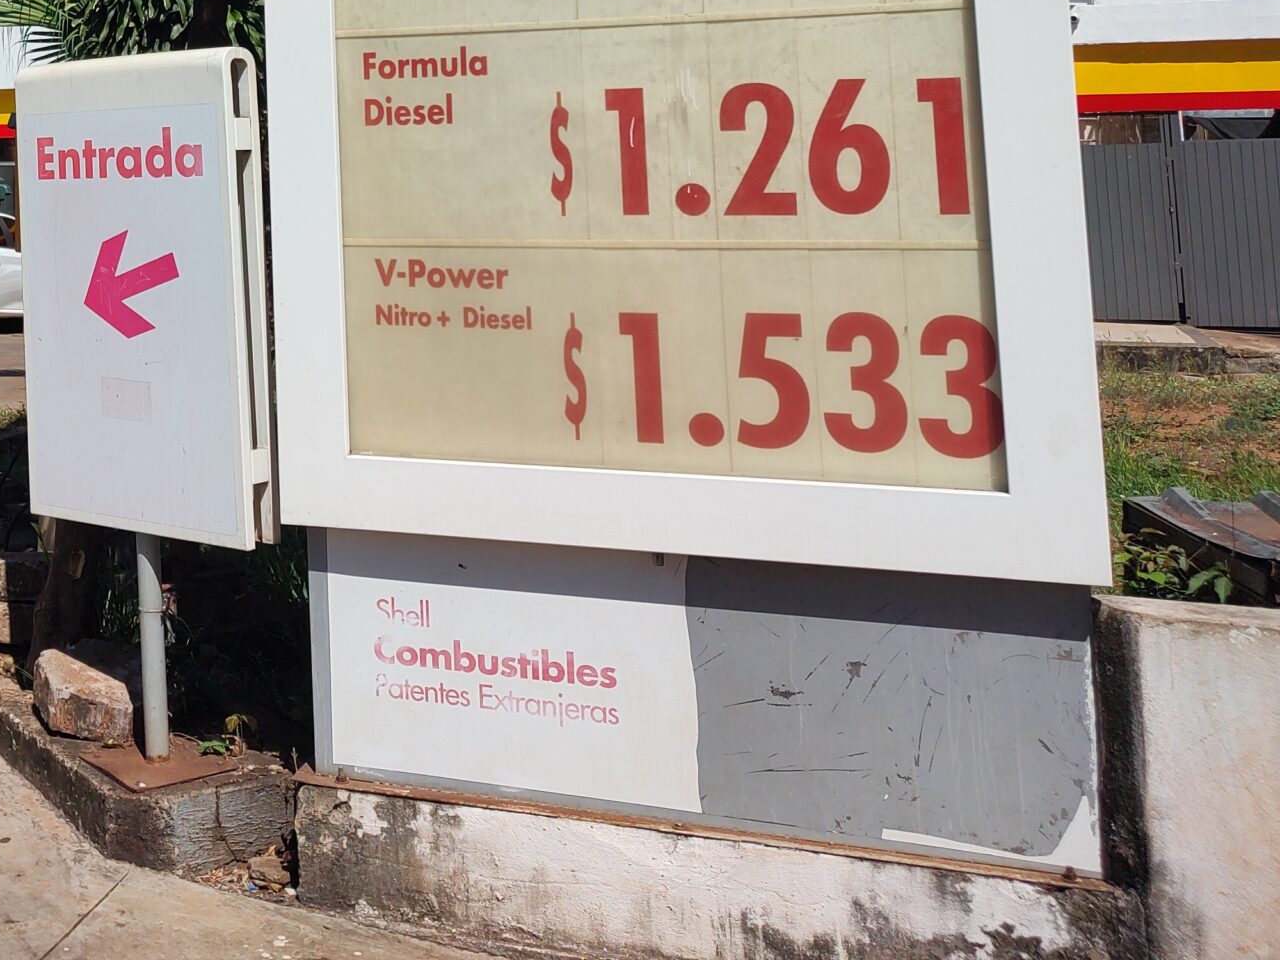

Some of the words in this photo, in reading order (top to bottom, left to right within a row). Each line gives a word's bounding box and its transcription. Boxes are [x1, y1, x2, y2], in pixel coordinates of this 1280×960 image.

[362, 46, 489, 81] Formula
[364, 93, 454, 128] Diesel
[36, 126, 204, 181] Entrada
[549, 91, 574, 217] $
[604, 77, 972, 218] 1.261
[375, 258, 509, 290] V-Power
[463, 305, 533, 331] Diesel
[562, 311, 589, 441] $
[618, 311, 1006, 460] 1.533
[376, 596, 431, 628] Shell
[373, 635, 619, 689] Combustibles
[375, 672, 471, 708] Patentes
[479, 683, 620, 727] Extranjeras
